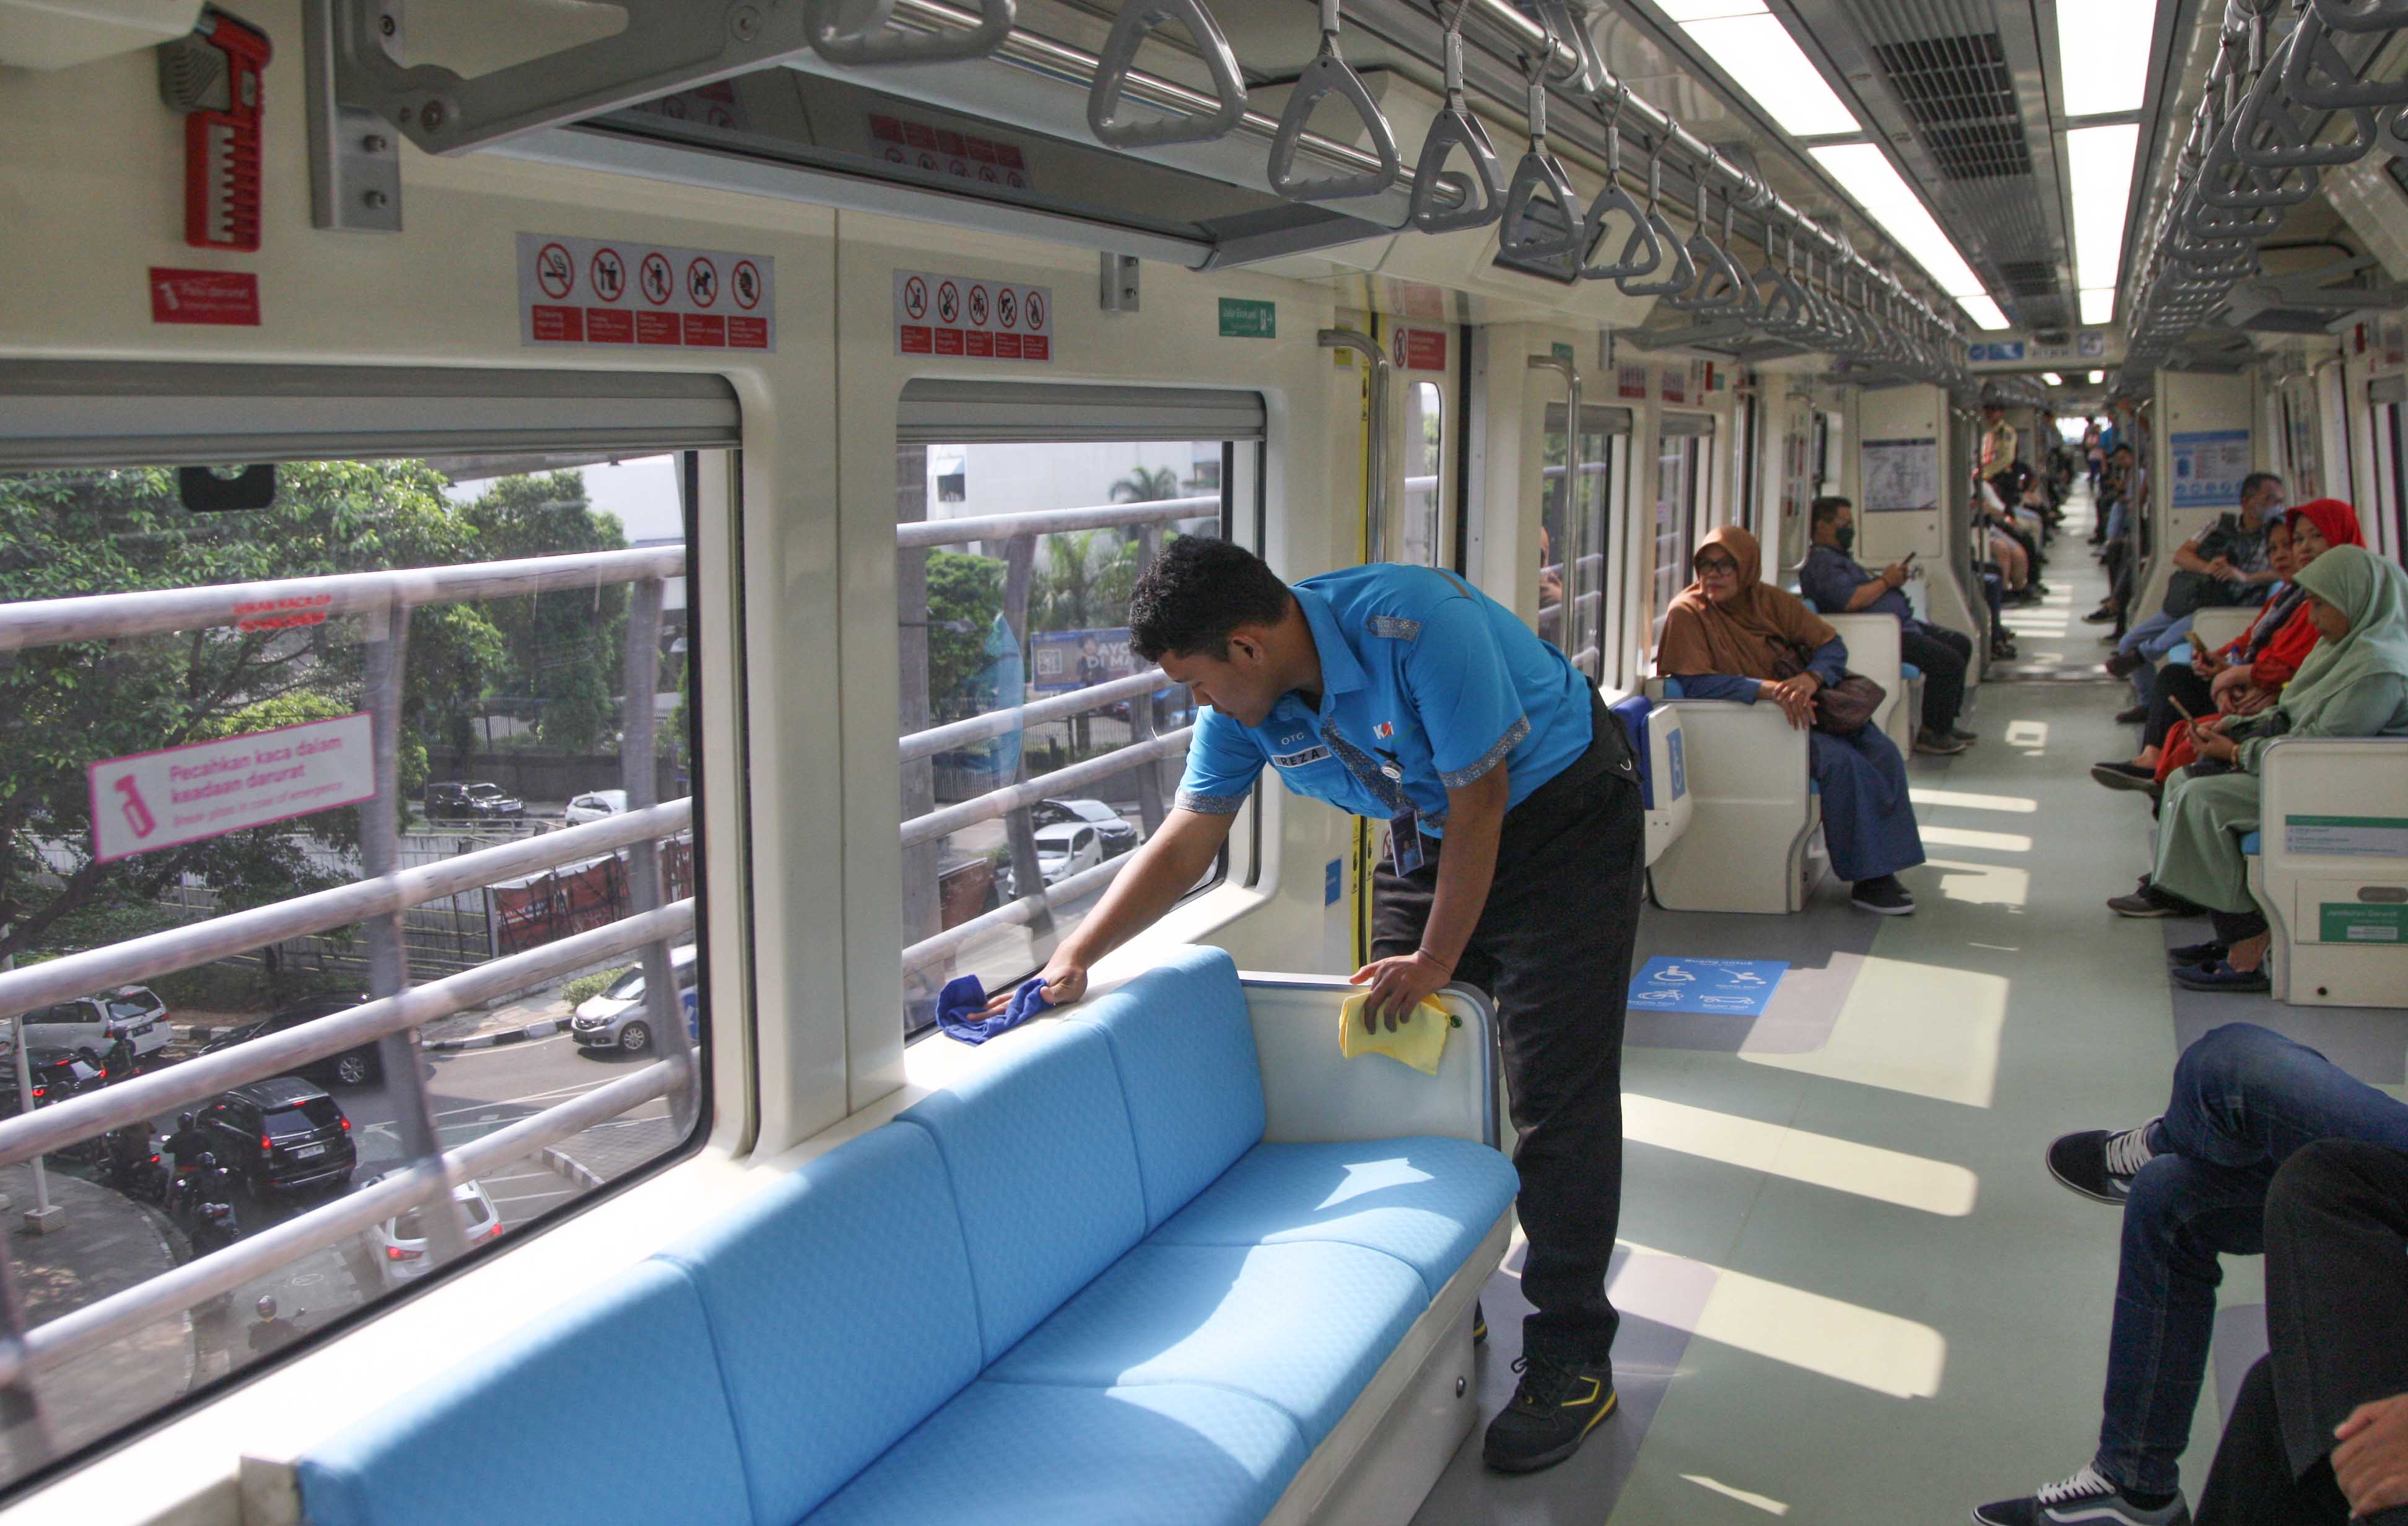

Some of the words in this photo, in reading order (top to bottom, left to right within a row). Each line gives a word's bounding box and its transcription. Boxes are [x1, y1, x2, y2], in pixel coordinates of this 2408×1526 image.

[1281, 732, 1305, 745] OTG
[170, 755, 251, 782] Pecahkan
[255, 747, 292, 764] kaca
[295, 737, 342, 756] dalam
[1280, 749, 1321, 766] REZA
[170, 778, 243, 804] keadaan
[246, 764, 306, 788] darurat
